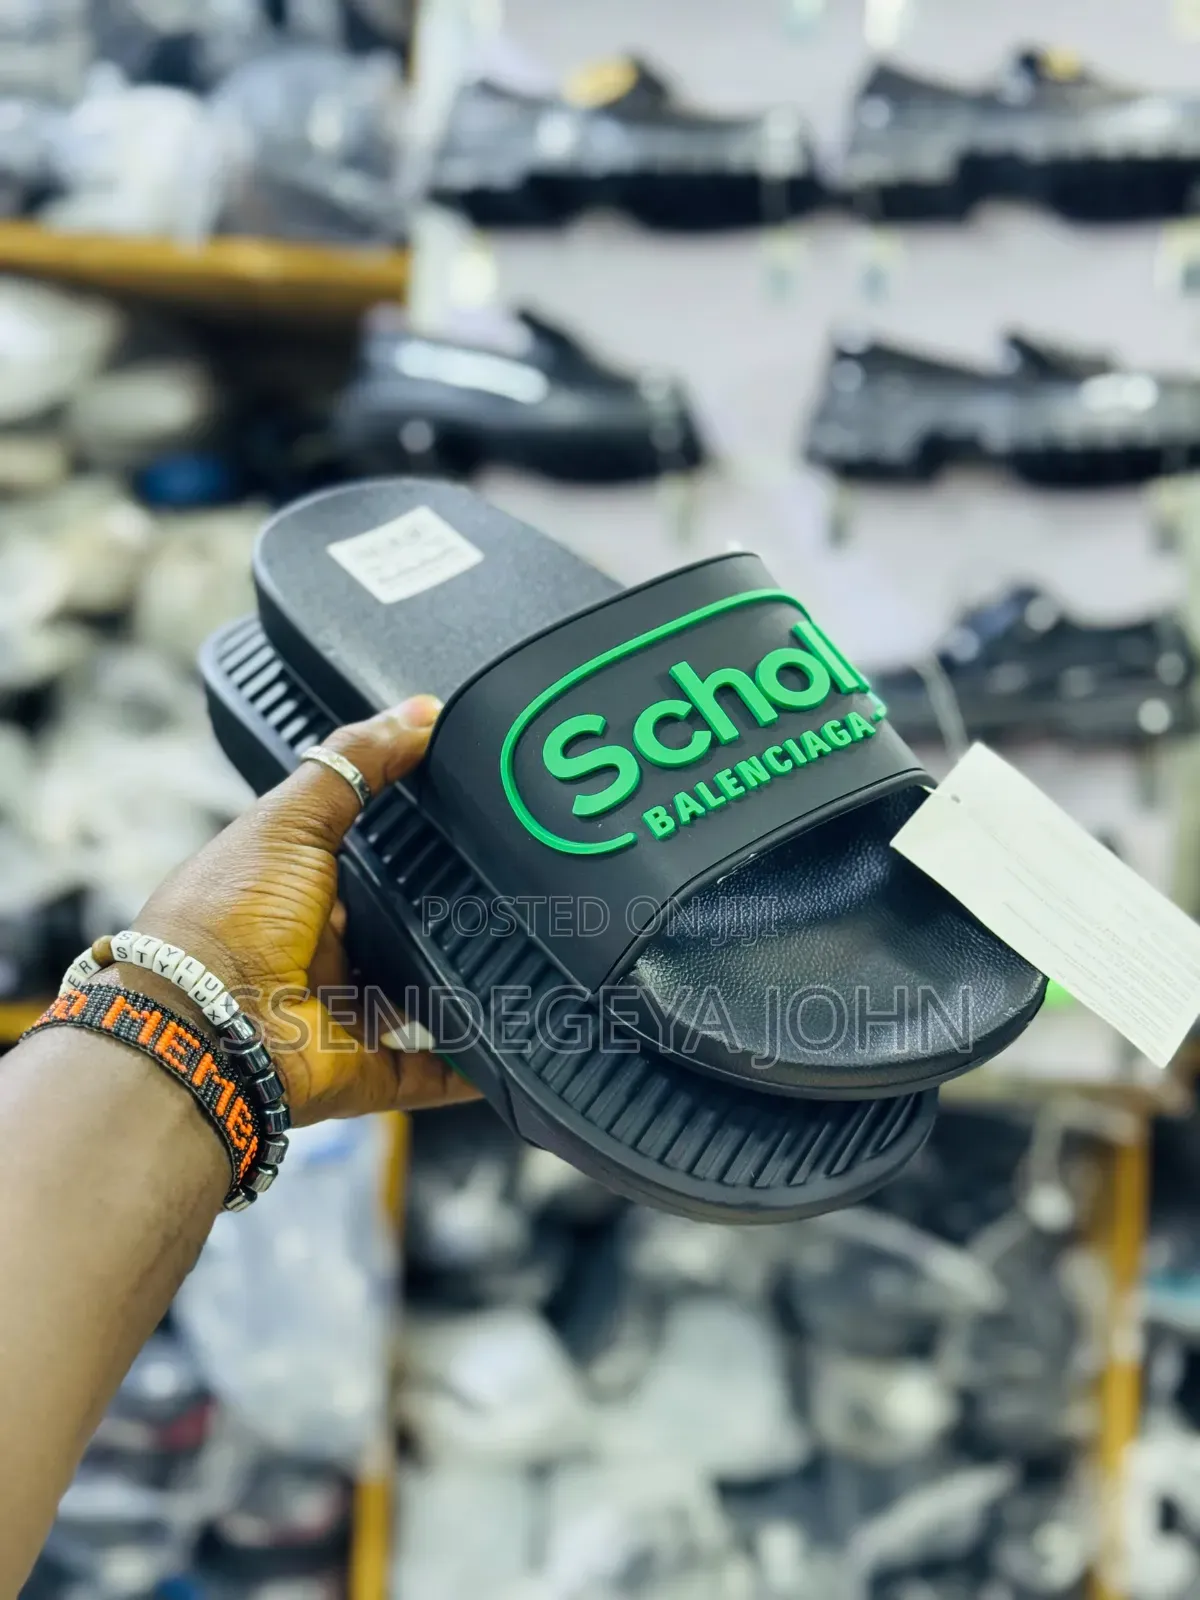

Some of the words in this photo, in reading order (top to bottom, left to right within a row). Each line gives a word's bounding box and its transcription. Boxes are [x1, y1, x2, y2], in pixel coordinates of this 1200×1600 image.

[542, 620, 870, 818] Schol
[641, 710, 877, 841] BALENCIAGA
[116, 946, 221, 1022] STYLUX
